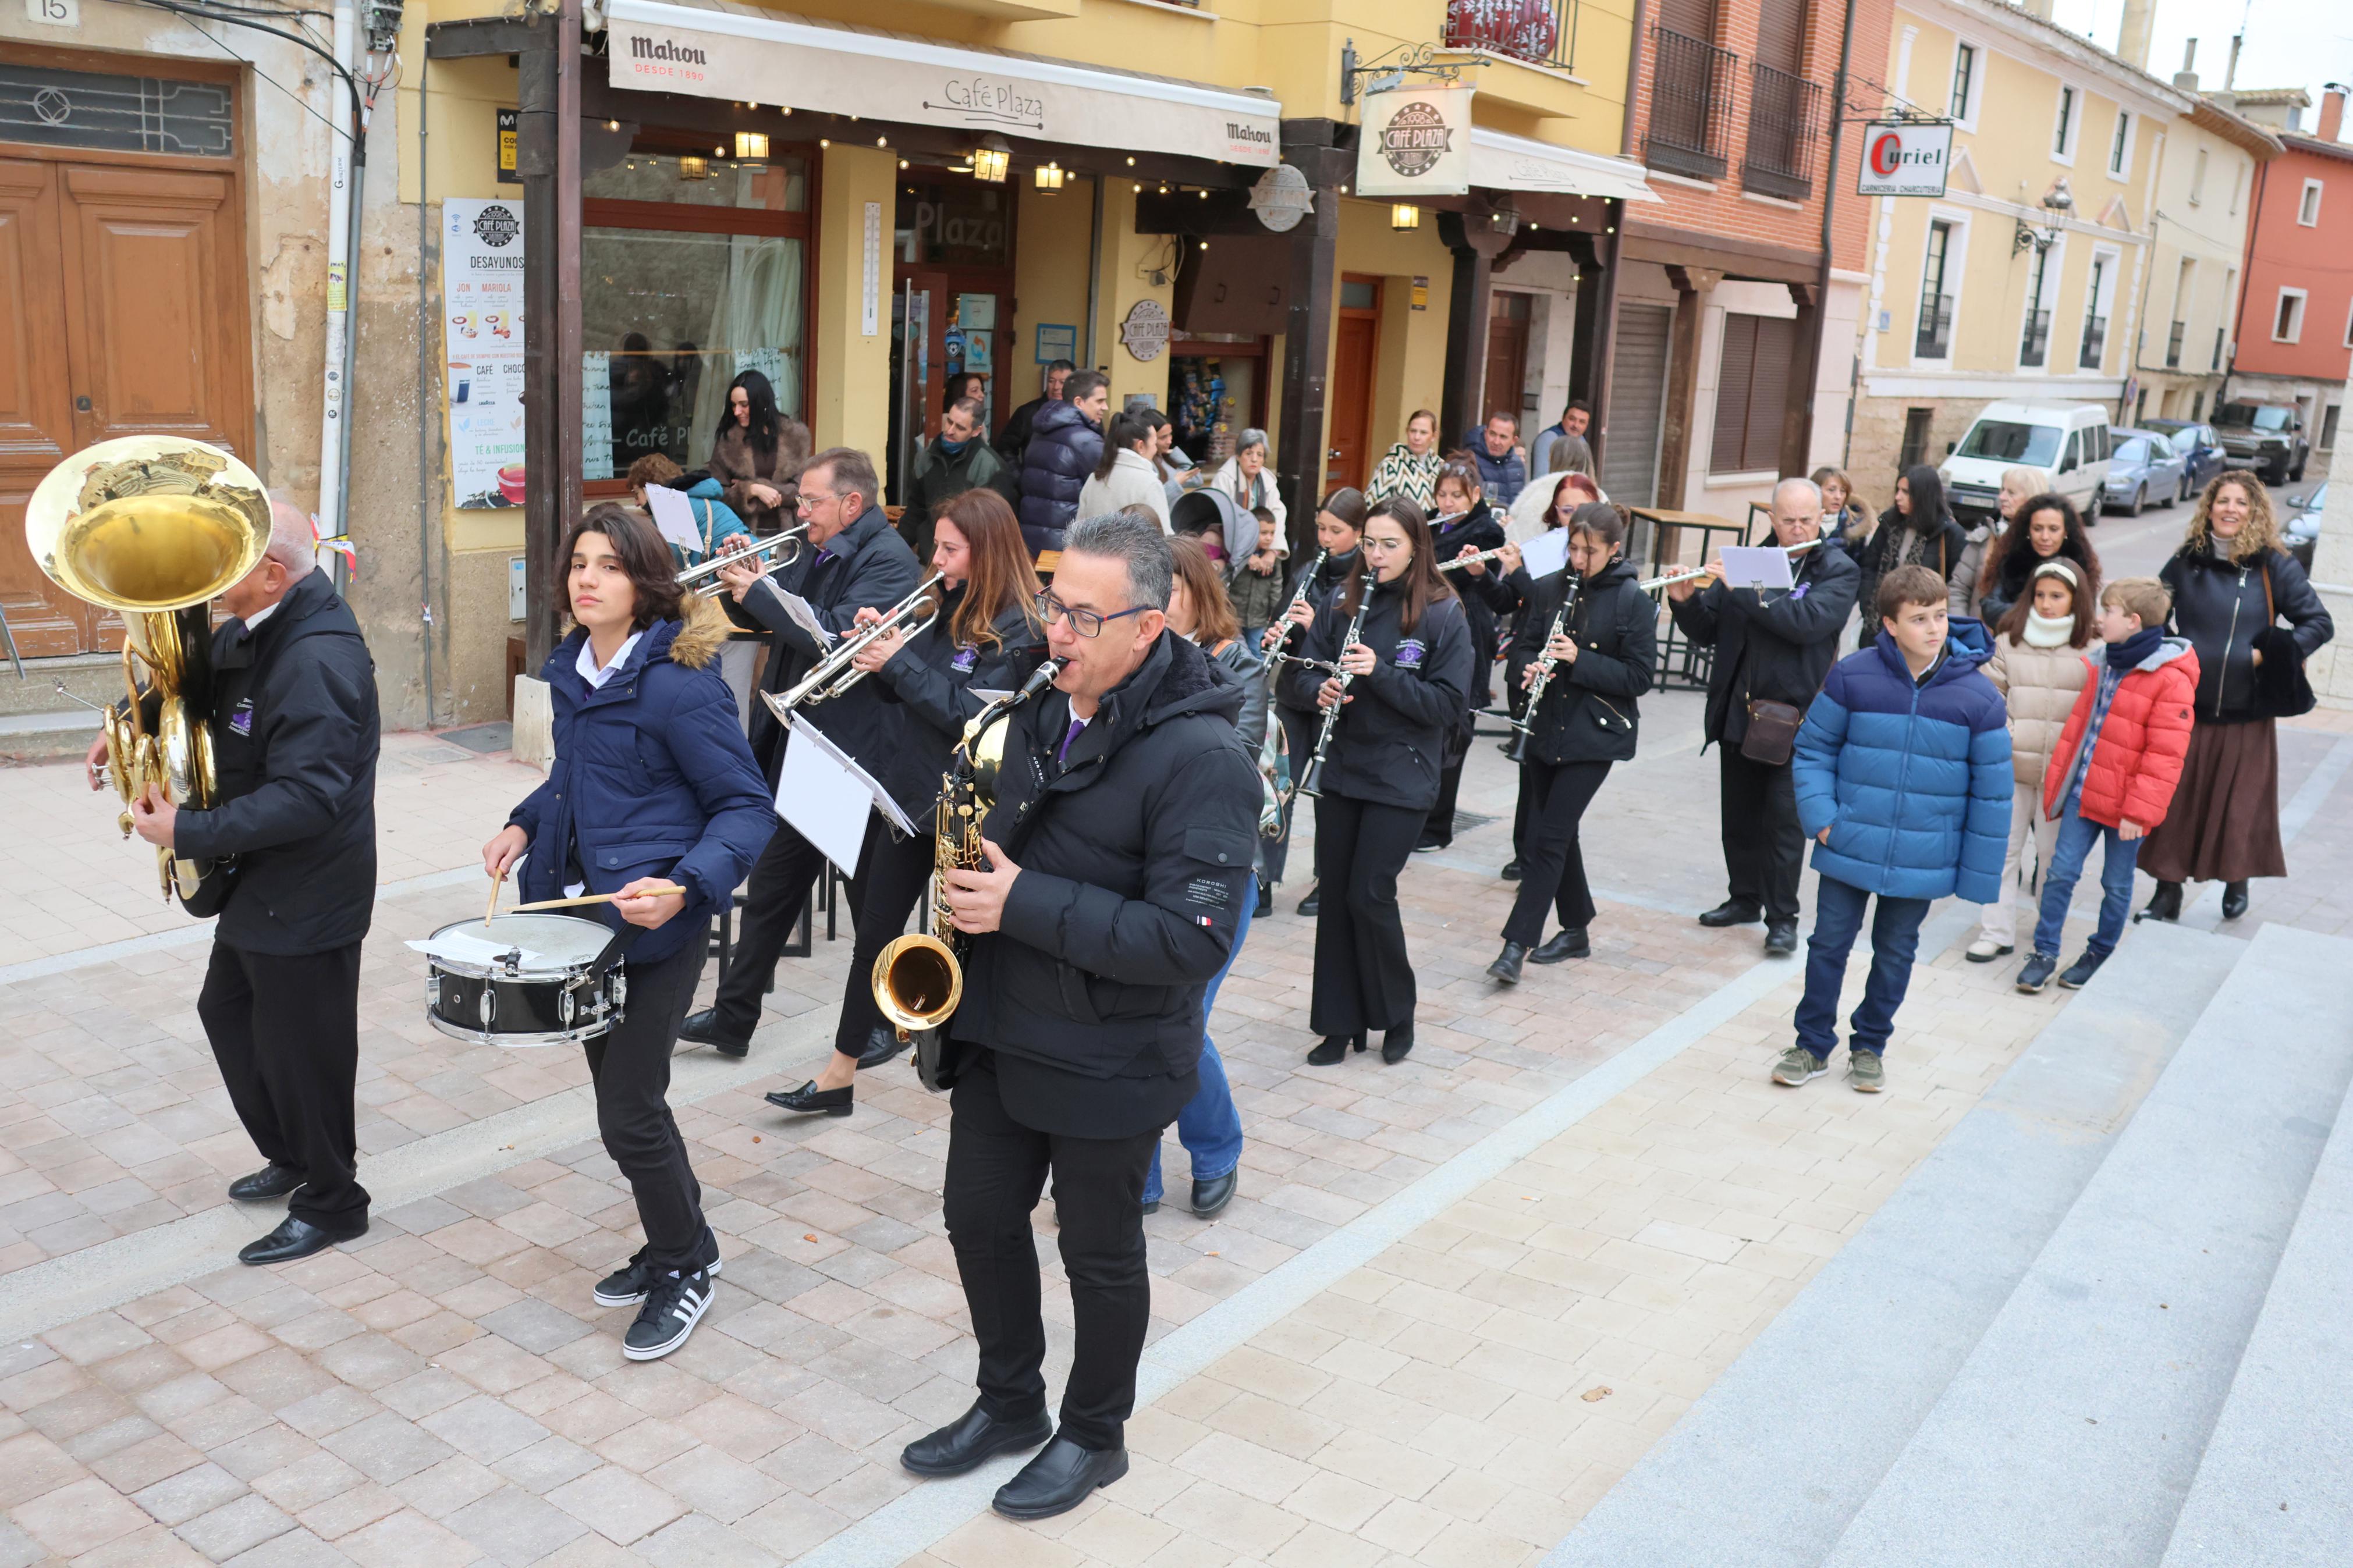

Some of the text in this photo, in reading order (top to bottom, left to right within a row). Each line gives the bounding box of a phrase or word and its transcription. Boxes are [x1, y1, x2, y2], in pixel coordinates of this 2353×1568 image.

[42, 0, 66, 19] 15
[631, 36, 707, 65] Mahou
[635, 64, 703, 81] DESDE 1890
[945, 78, 1043, 119] Café Plaza
[1226, 122, 1271, 143] Mahou
[1386, 127, 1444, 148] CAFÉ PLAZA
[1871, 133, 1942, 175] Curiel
[1862, 184, 1942, 194] CARNICERIA CHARCUTERIA
[479, 219, 514, 231] CAFÉ PLAZA
[915, 201, 1003, 246] Plaza
[470, 256, 524, 269] DESAYUNOS
[457, 283, 470, 292] JON
[482, 283, 512, 292] MARIOLA
[1147, 322, 1168, 336] PLAZA
[477, 364, 494, 375] CAFÉ
[626, 426, 669, 447] Café
[475, 444, 484, 455] TÉ
[486, 446, 491, 454] &
[1197, 878, 1227, 888] KOROSHI
